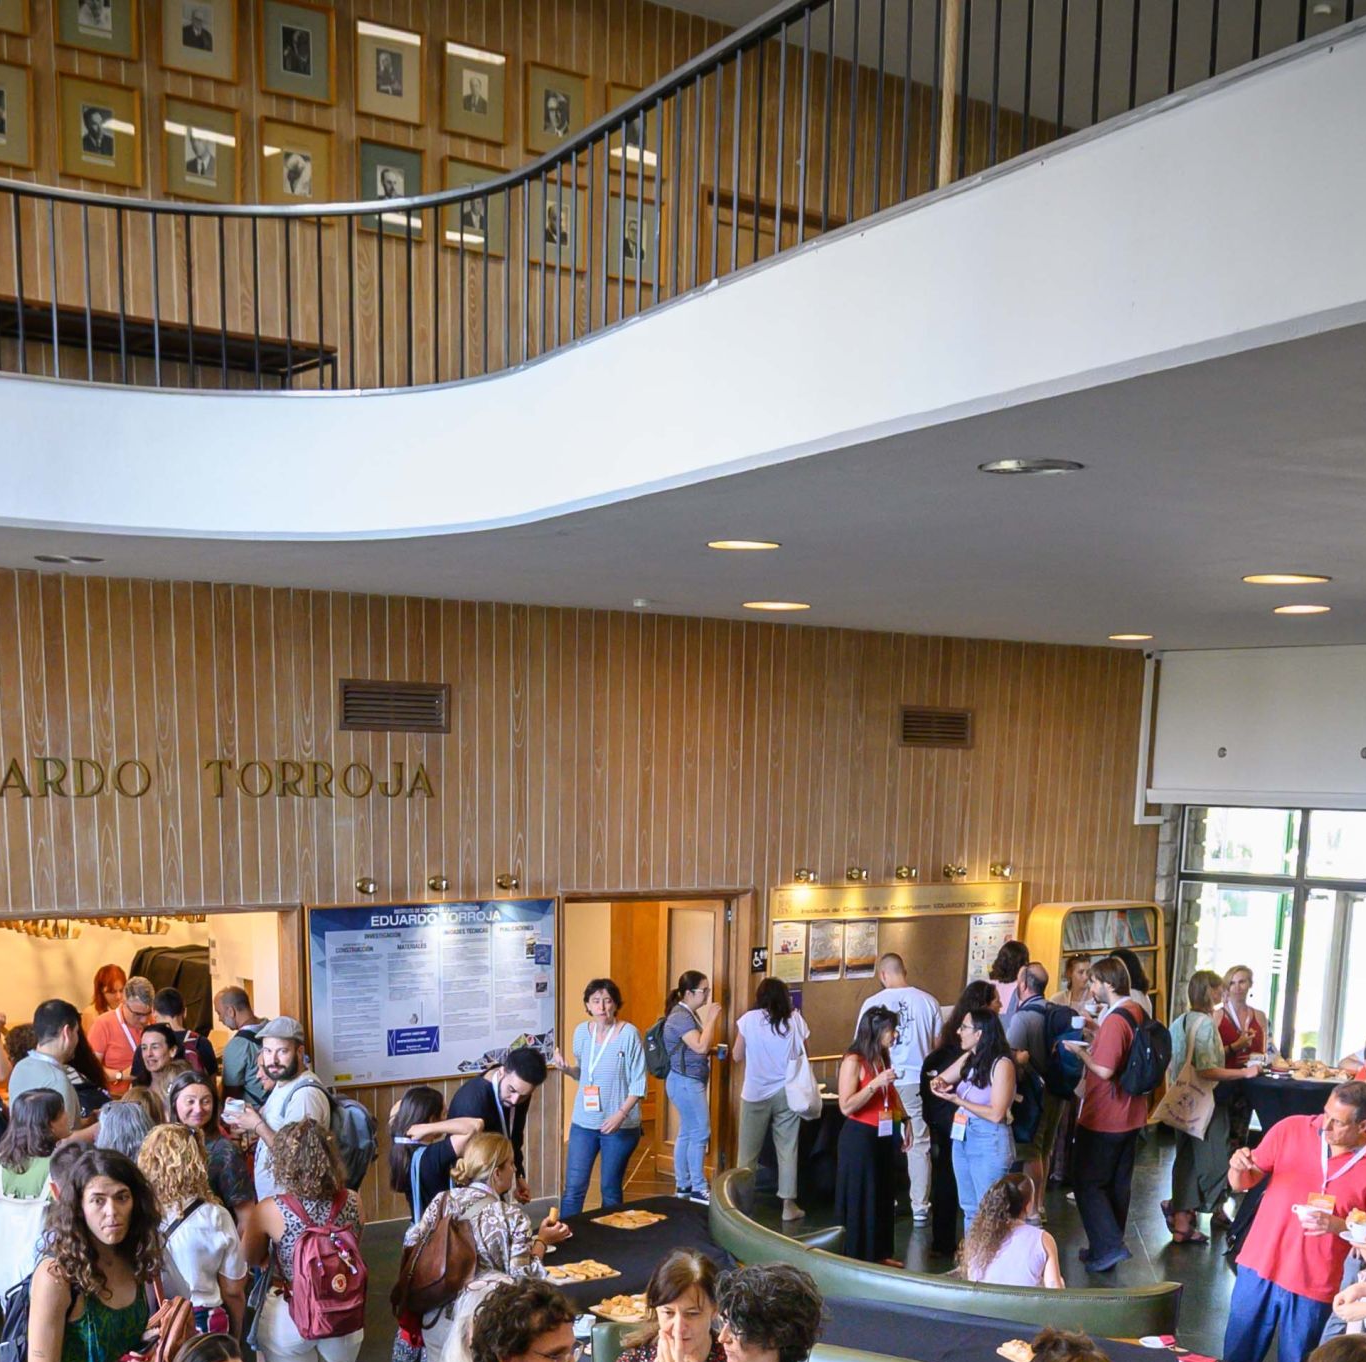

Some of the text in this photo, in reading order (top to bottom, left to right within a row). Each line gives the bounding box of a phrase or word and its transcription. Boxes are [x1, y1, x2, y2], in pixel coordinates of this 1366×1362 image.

[203, 758, 435, 799] TORROJA
[370, 910, 502, 927] EDUARDO TORROJA
[973, 917, 983, 926] 15
